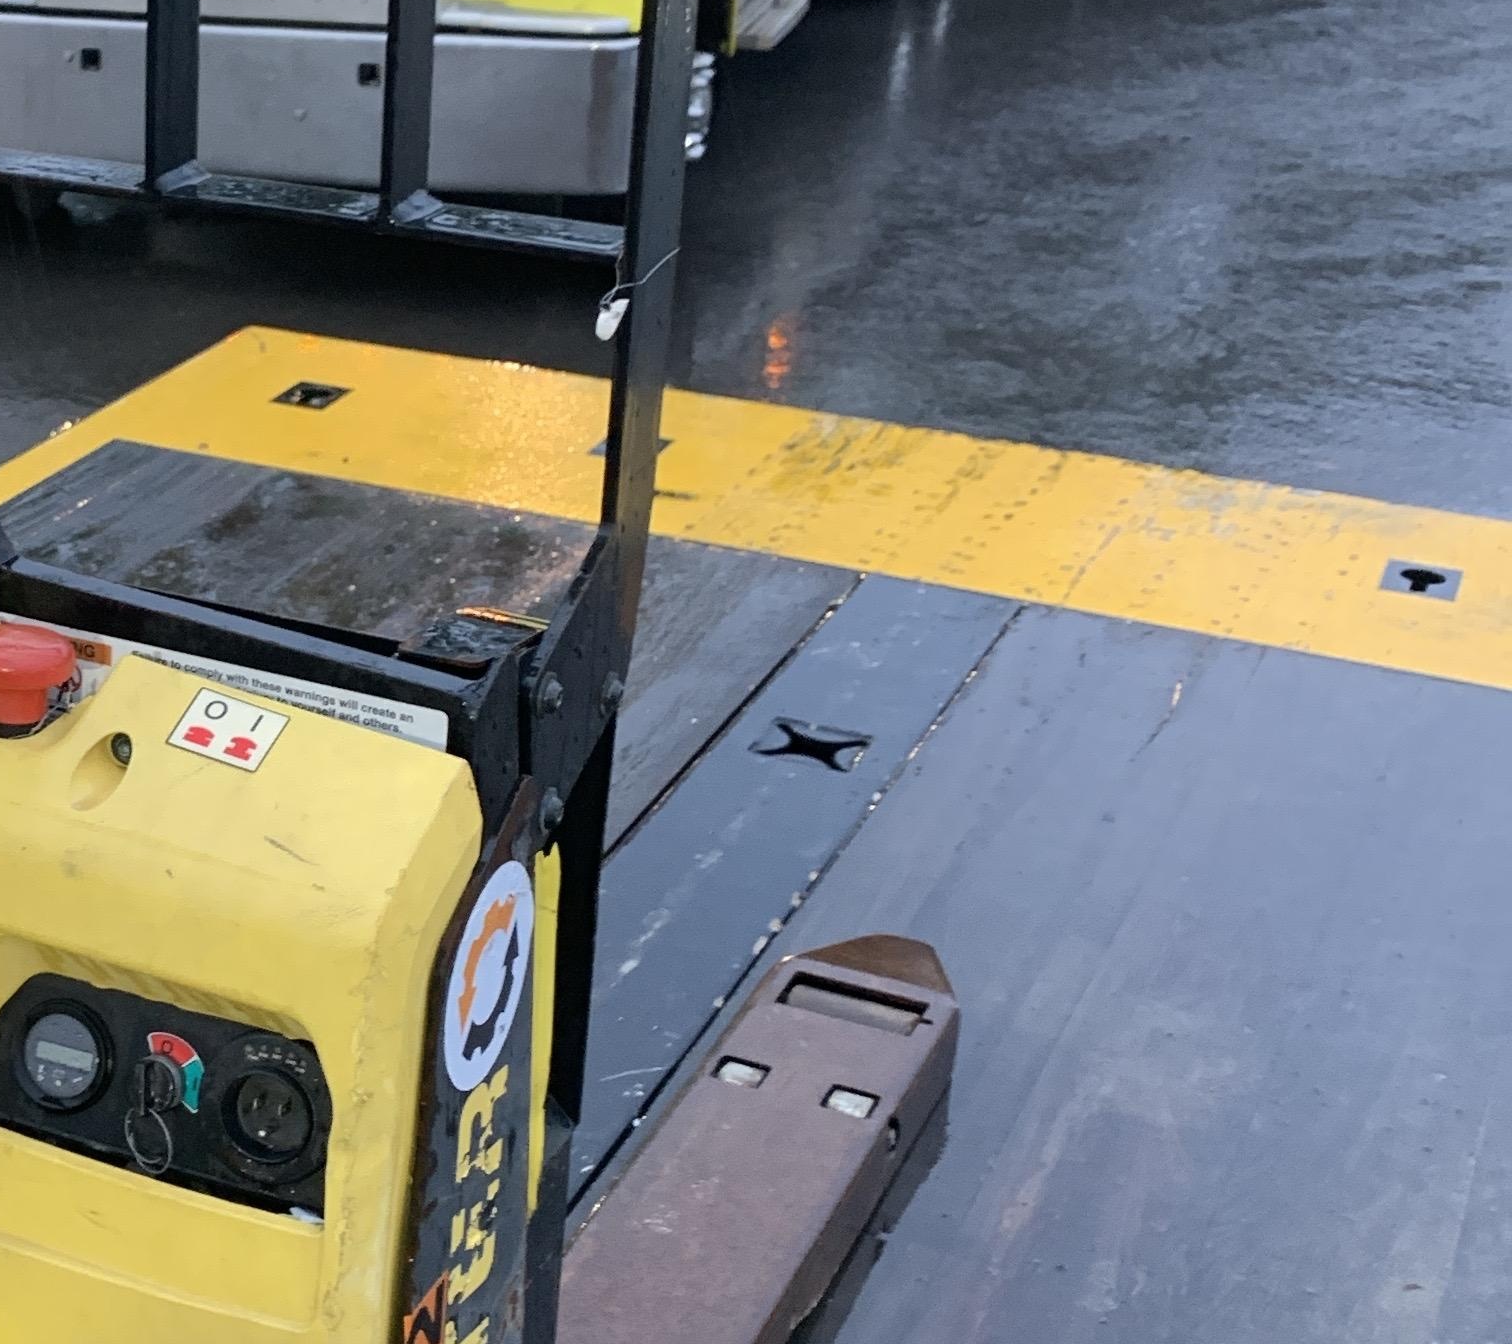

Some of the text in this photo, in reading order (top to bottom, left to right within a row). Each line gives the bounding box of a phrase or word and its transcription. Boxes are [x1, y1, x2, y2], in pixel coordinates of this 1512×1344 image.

[170, 659, 181, 671] to
[184, 663, 223, 682] comply
[226, 670, 249, 686] with
[251, 678, 281, 694] these
[285, 687, 336, 707] warnings
[339, 698, 359, 711] will
[361, 705, 396, 721] create
[399, 713, 414, 724] an
[338, 711, 359, 725] and
[362, 716, 402, 734] others.
